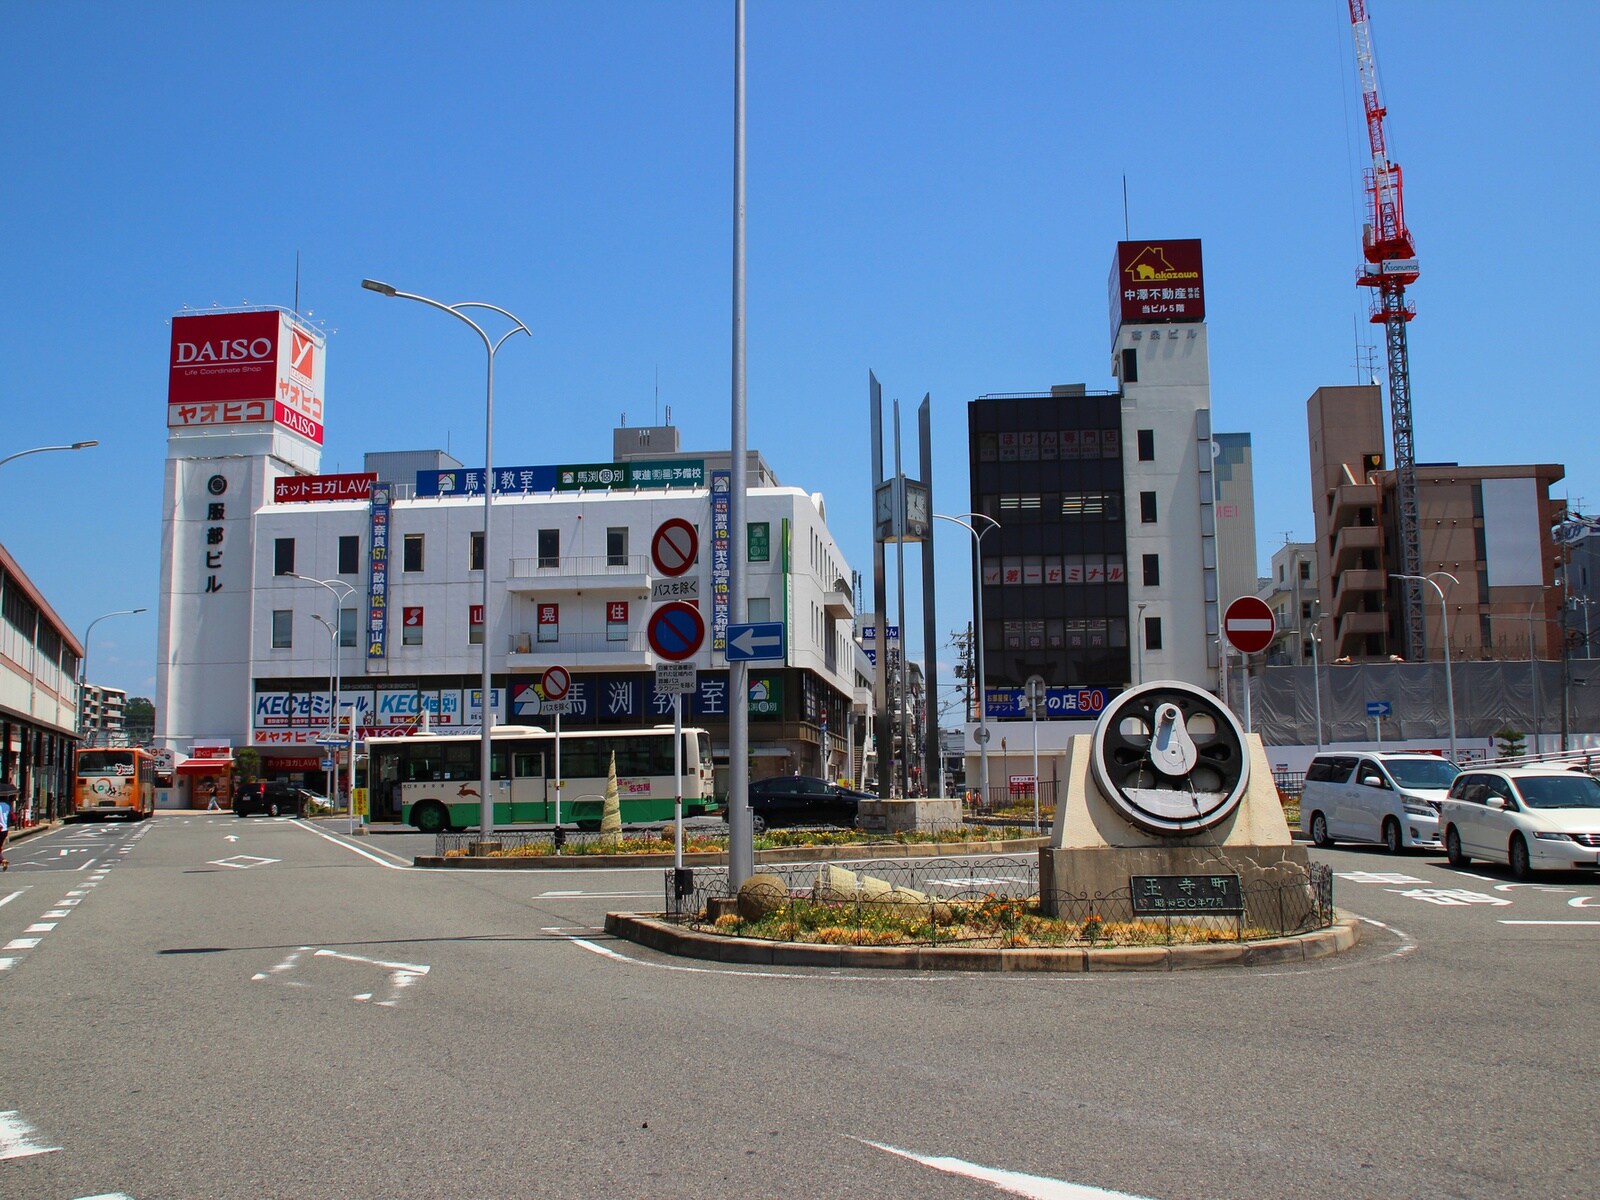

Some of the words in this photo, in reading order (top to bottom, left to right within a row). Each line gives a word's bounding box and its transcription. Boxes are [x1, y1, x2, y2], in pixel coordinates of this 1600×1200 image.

[1384, 262, 1418, 271] Asanuma
[1124, 288, 1187, 301] 中澤不動産
[176, 338, 272, 363] DAISO
[200, 367, 241, 375] Coordinate
[279, 377, 322, 420] ヤオヒコ
[178, 402, 265, 423] ヤオヒコ
[283, 408, 316, 438] DAISO
[1002, 430, 1117, 444] ほけん専門店
[464, 470, 533, 490] 馬渕教室
[577, 469, 624, 484] 馬渕個別
[632, 468, 702, 481] 東進衛星予備校
[276, 479, 372, 496] ホットヨガLAVA
[374, 525, 386, 547] 奈良
[205, 502, 225, 593] 服部ビル
[1005, 567, 1124, 582] 第一ゼミナール
[654, 581, 697, 596] バスを除く
[542, 607, 555, 622] 晃
[610, 604, 625, 620] 住
[371, 619, 383, 642] 郡山
[864, 628, 897, 637] 処ん
[257, 695, 368, 715] KECゼミナール
[543, 702, 569, 711] バスを除く
[748, 701, 777, 712] 渕個別
[987, 704, 1014, 712] テナント
[268, 759, 317, 767] ホットヨガLAVA
[629, 783, 650, 792] 名古屋
[1143, 877, 1229, 896] 王寺町
